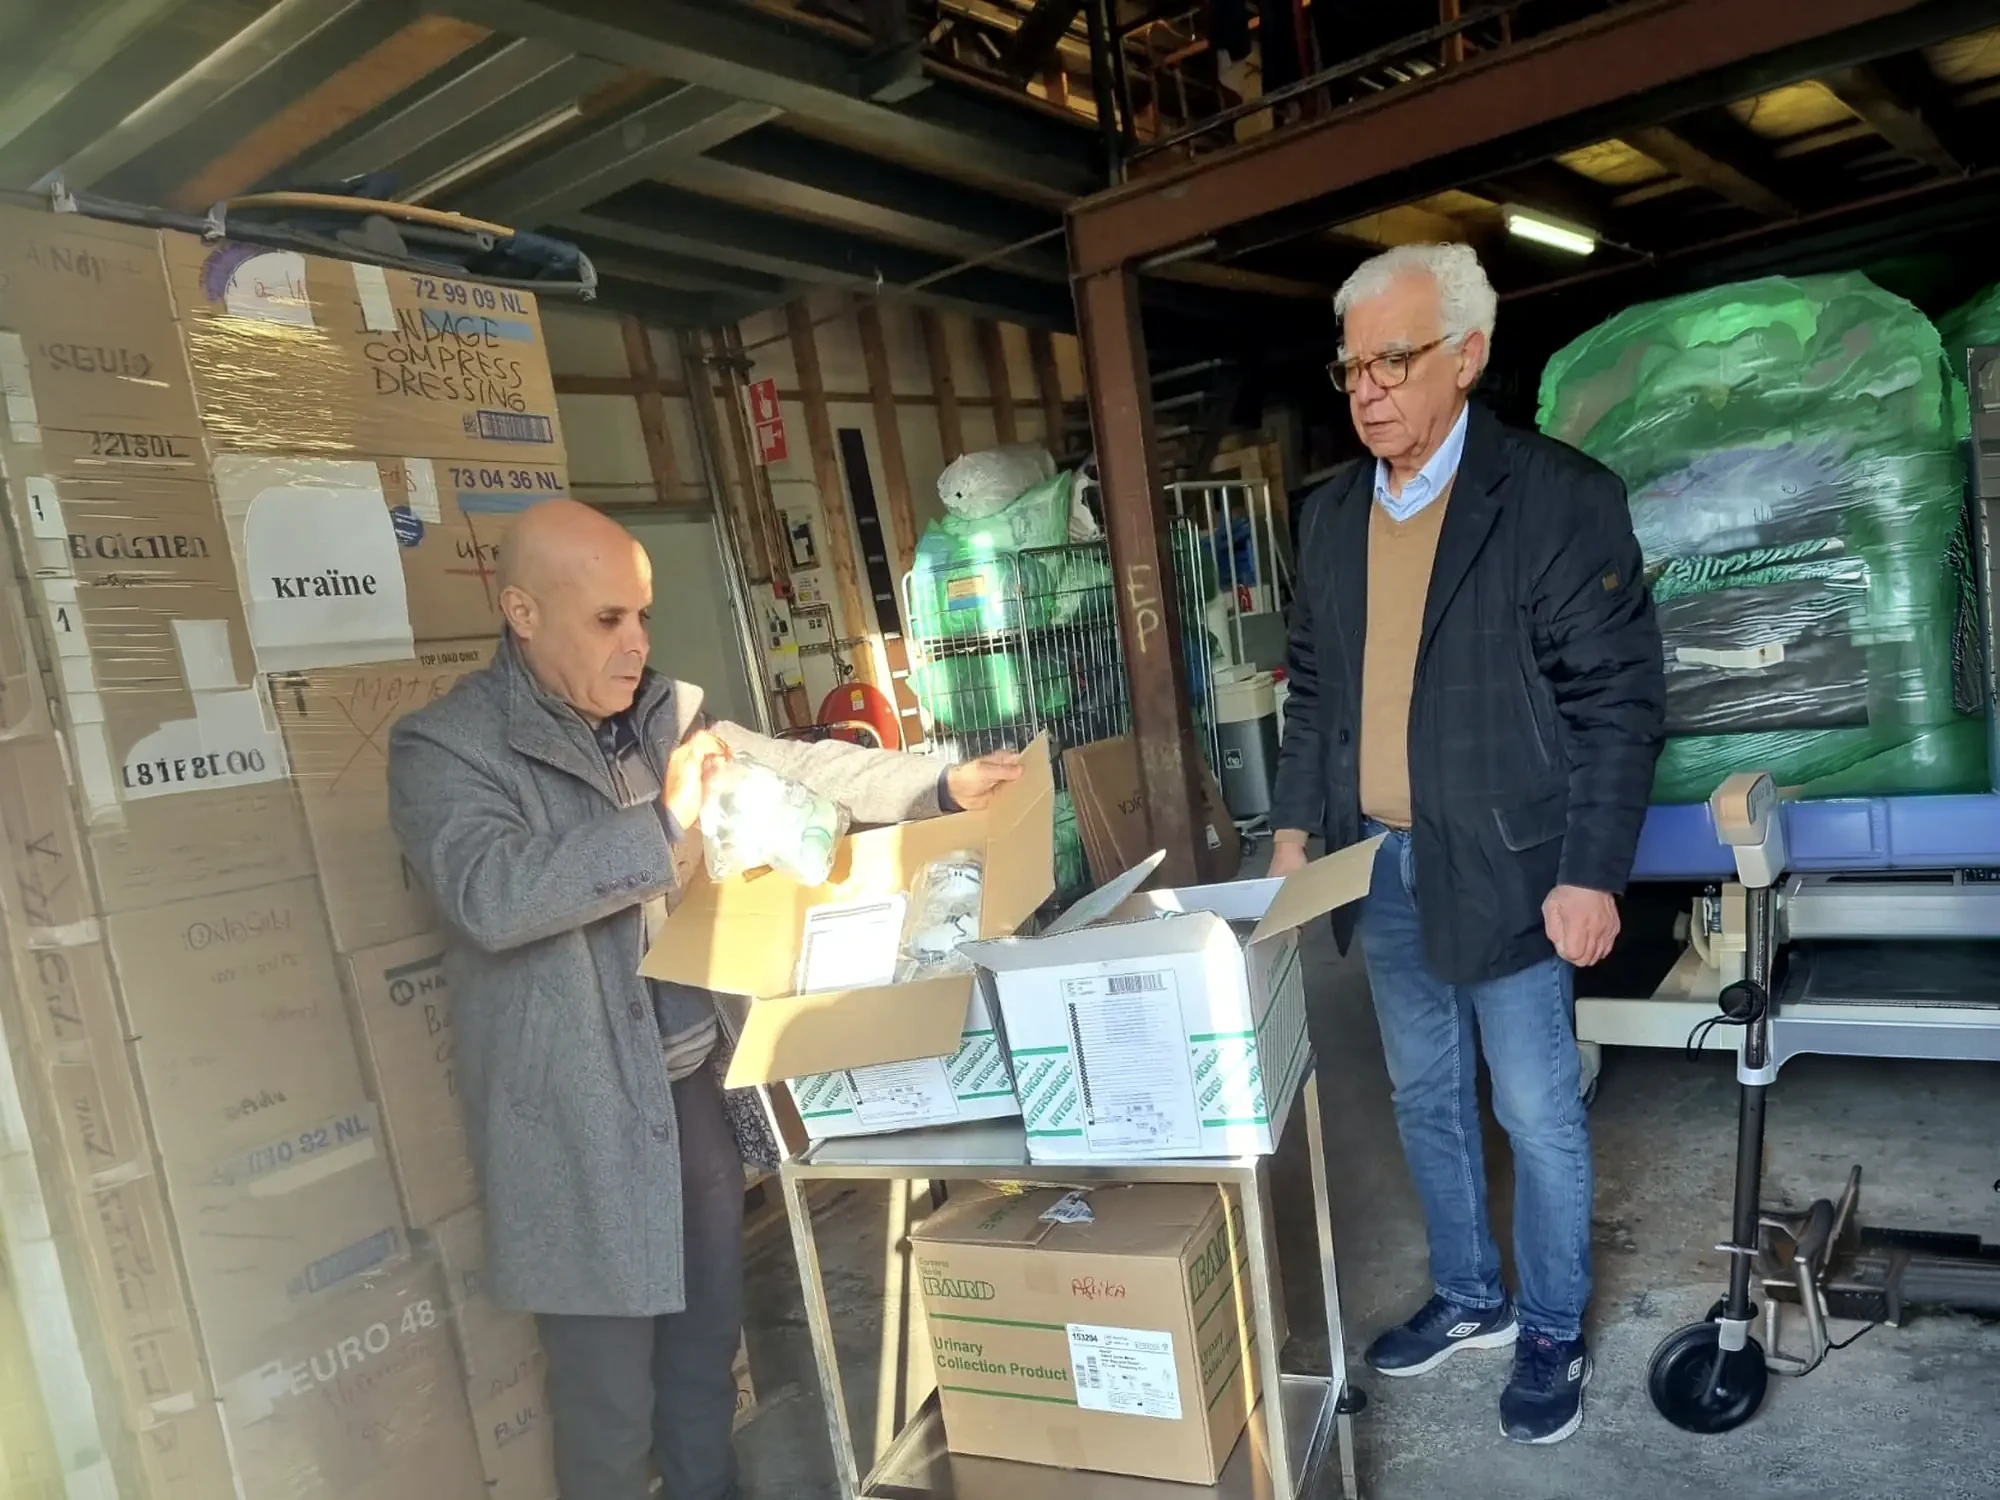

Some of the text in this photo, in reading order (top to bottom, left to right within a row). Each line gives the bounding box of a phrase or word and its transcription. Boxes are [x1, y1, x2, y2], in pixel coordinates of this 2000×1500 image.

[409, 276, 529, 315] 72 99 09 NL
[354, 300, 501, 349] NDAGE
[363, 341, 523, 390] COMPRESS
[371, 365, 527, 412] DRESSING
[449, 467, 565, 491] 73 04 36 NL
[420, 653, 437, 667] TOP
[335, 1113, 369, 1141] NL
[923, 1276, 996, 1301] BARD
[290, 1321, 391, 1396] EURO
[400, 1299, 436, 1334] 48
[933, 1336, 984, 1357] Urinary
[936, 1354, 1069, 1383] Collection Product
